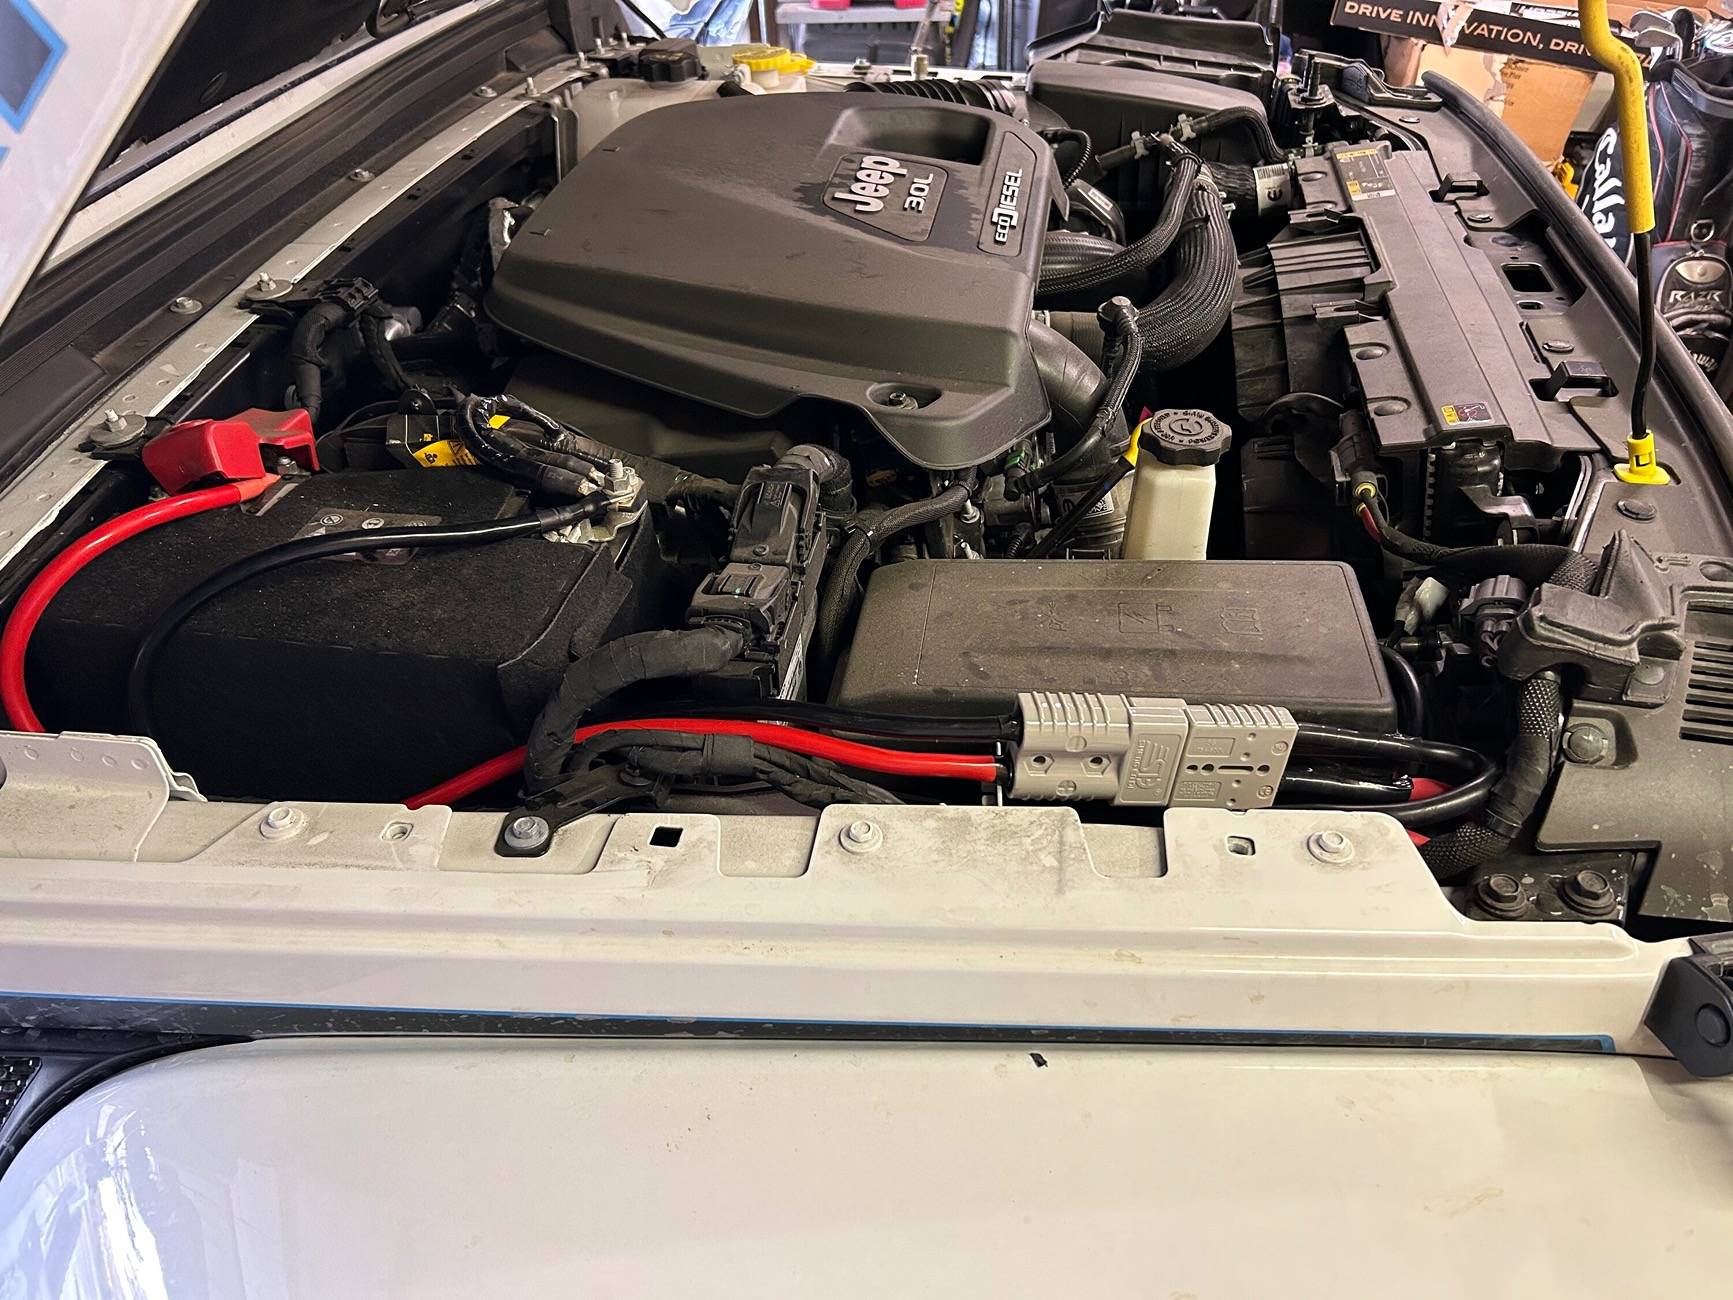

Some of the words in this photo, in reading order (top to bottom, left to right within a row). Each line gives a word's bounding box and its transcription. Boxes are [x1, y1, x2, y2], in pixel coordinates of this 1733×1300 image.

[1344, 1, 1403, 22] DRIVE
[1406, 10, 1544, 50] INNVATION,
[833, 155, 908, 212] Jeep
[1592, 127, 1625, 249] Calla
[1669, 290, 1723, 303] RAZR
